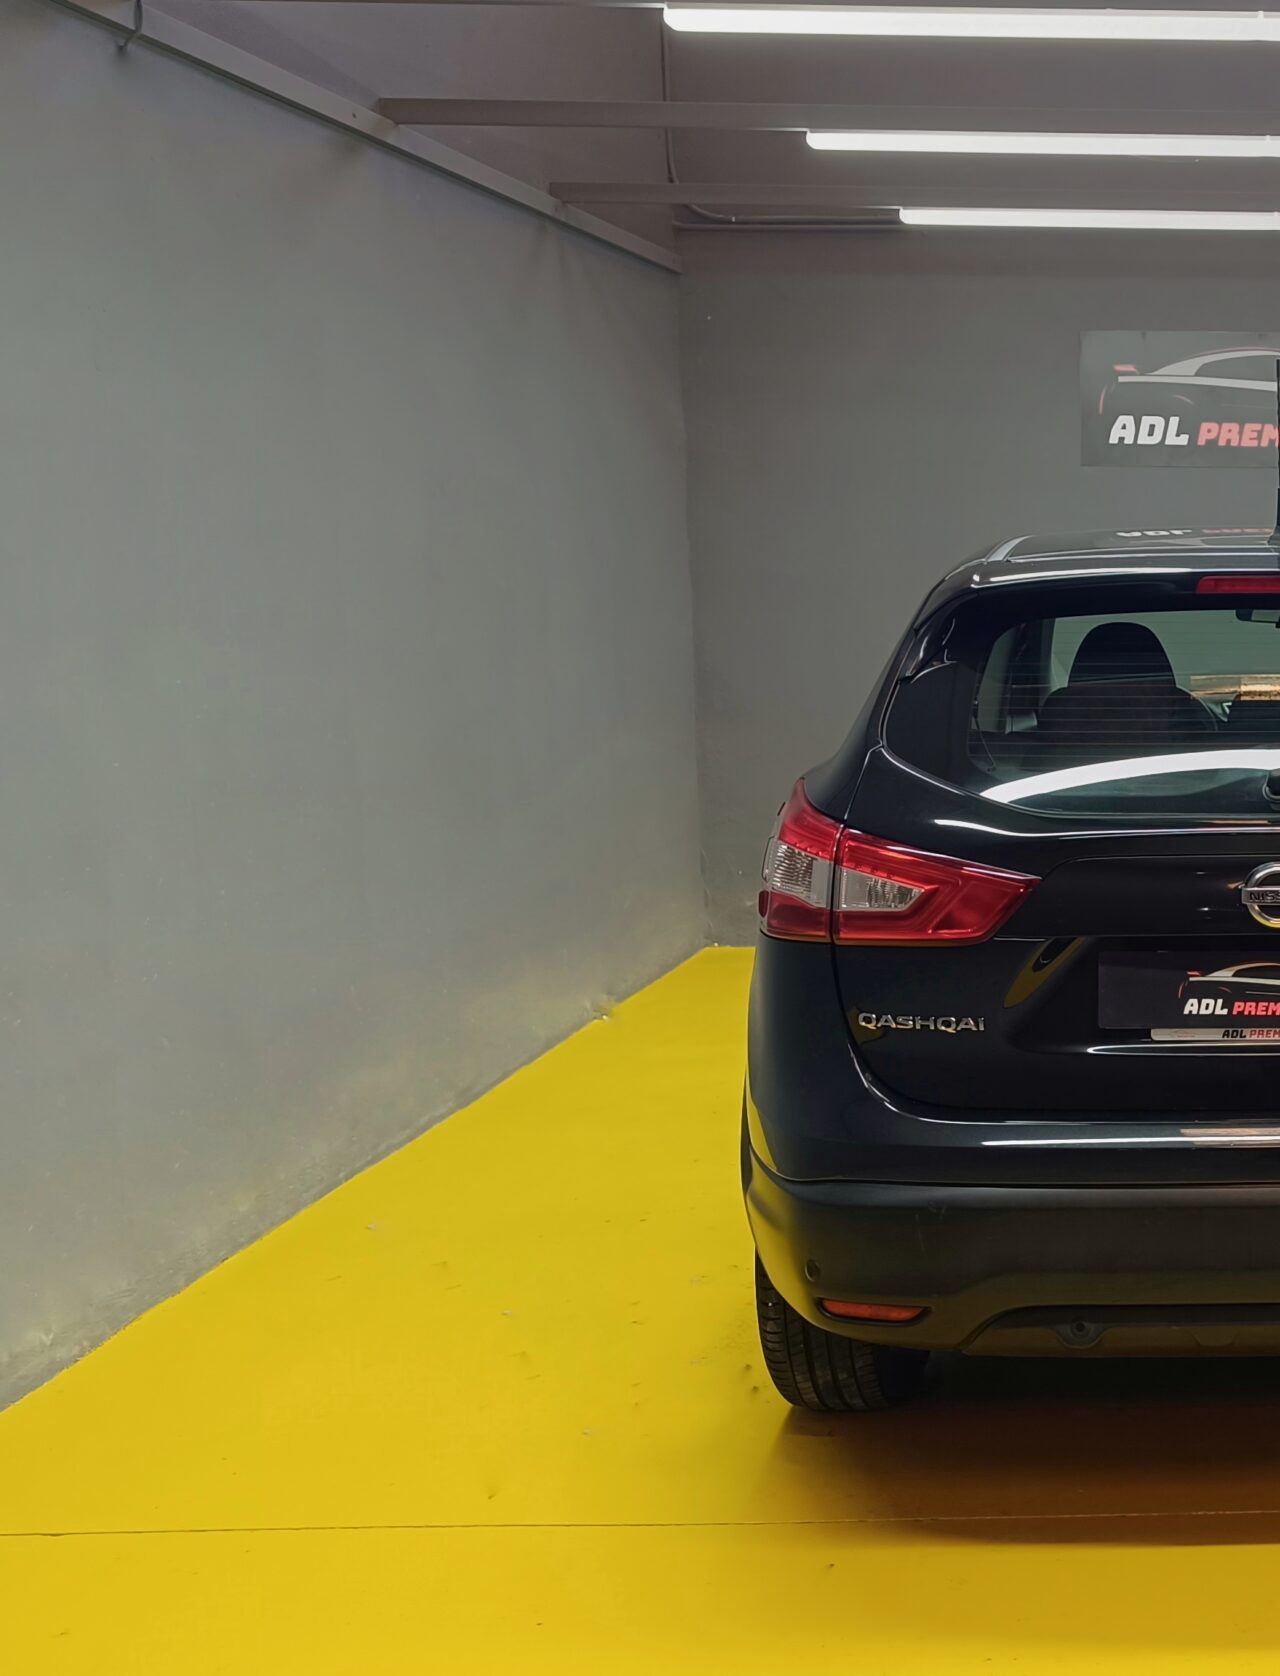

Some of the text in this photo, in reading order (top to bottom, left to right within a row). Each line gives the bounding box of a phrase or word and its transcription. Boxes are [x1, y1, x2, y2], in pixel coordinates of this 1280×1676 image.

[1108, 415, 1189, 446] ADL
[1183, 998, 1228, 1015] ADL
[858, 1012, 985, 1033] QASHQAI
[1222, 1029, 1247, 1039] ADL
